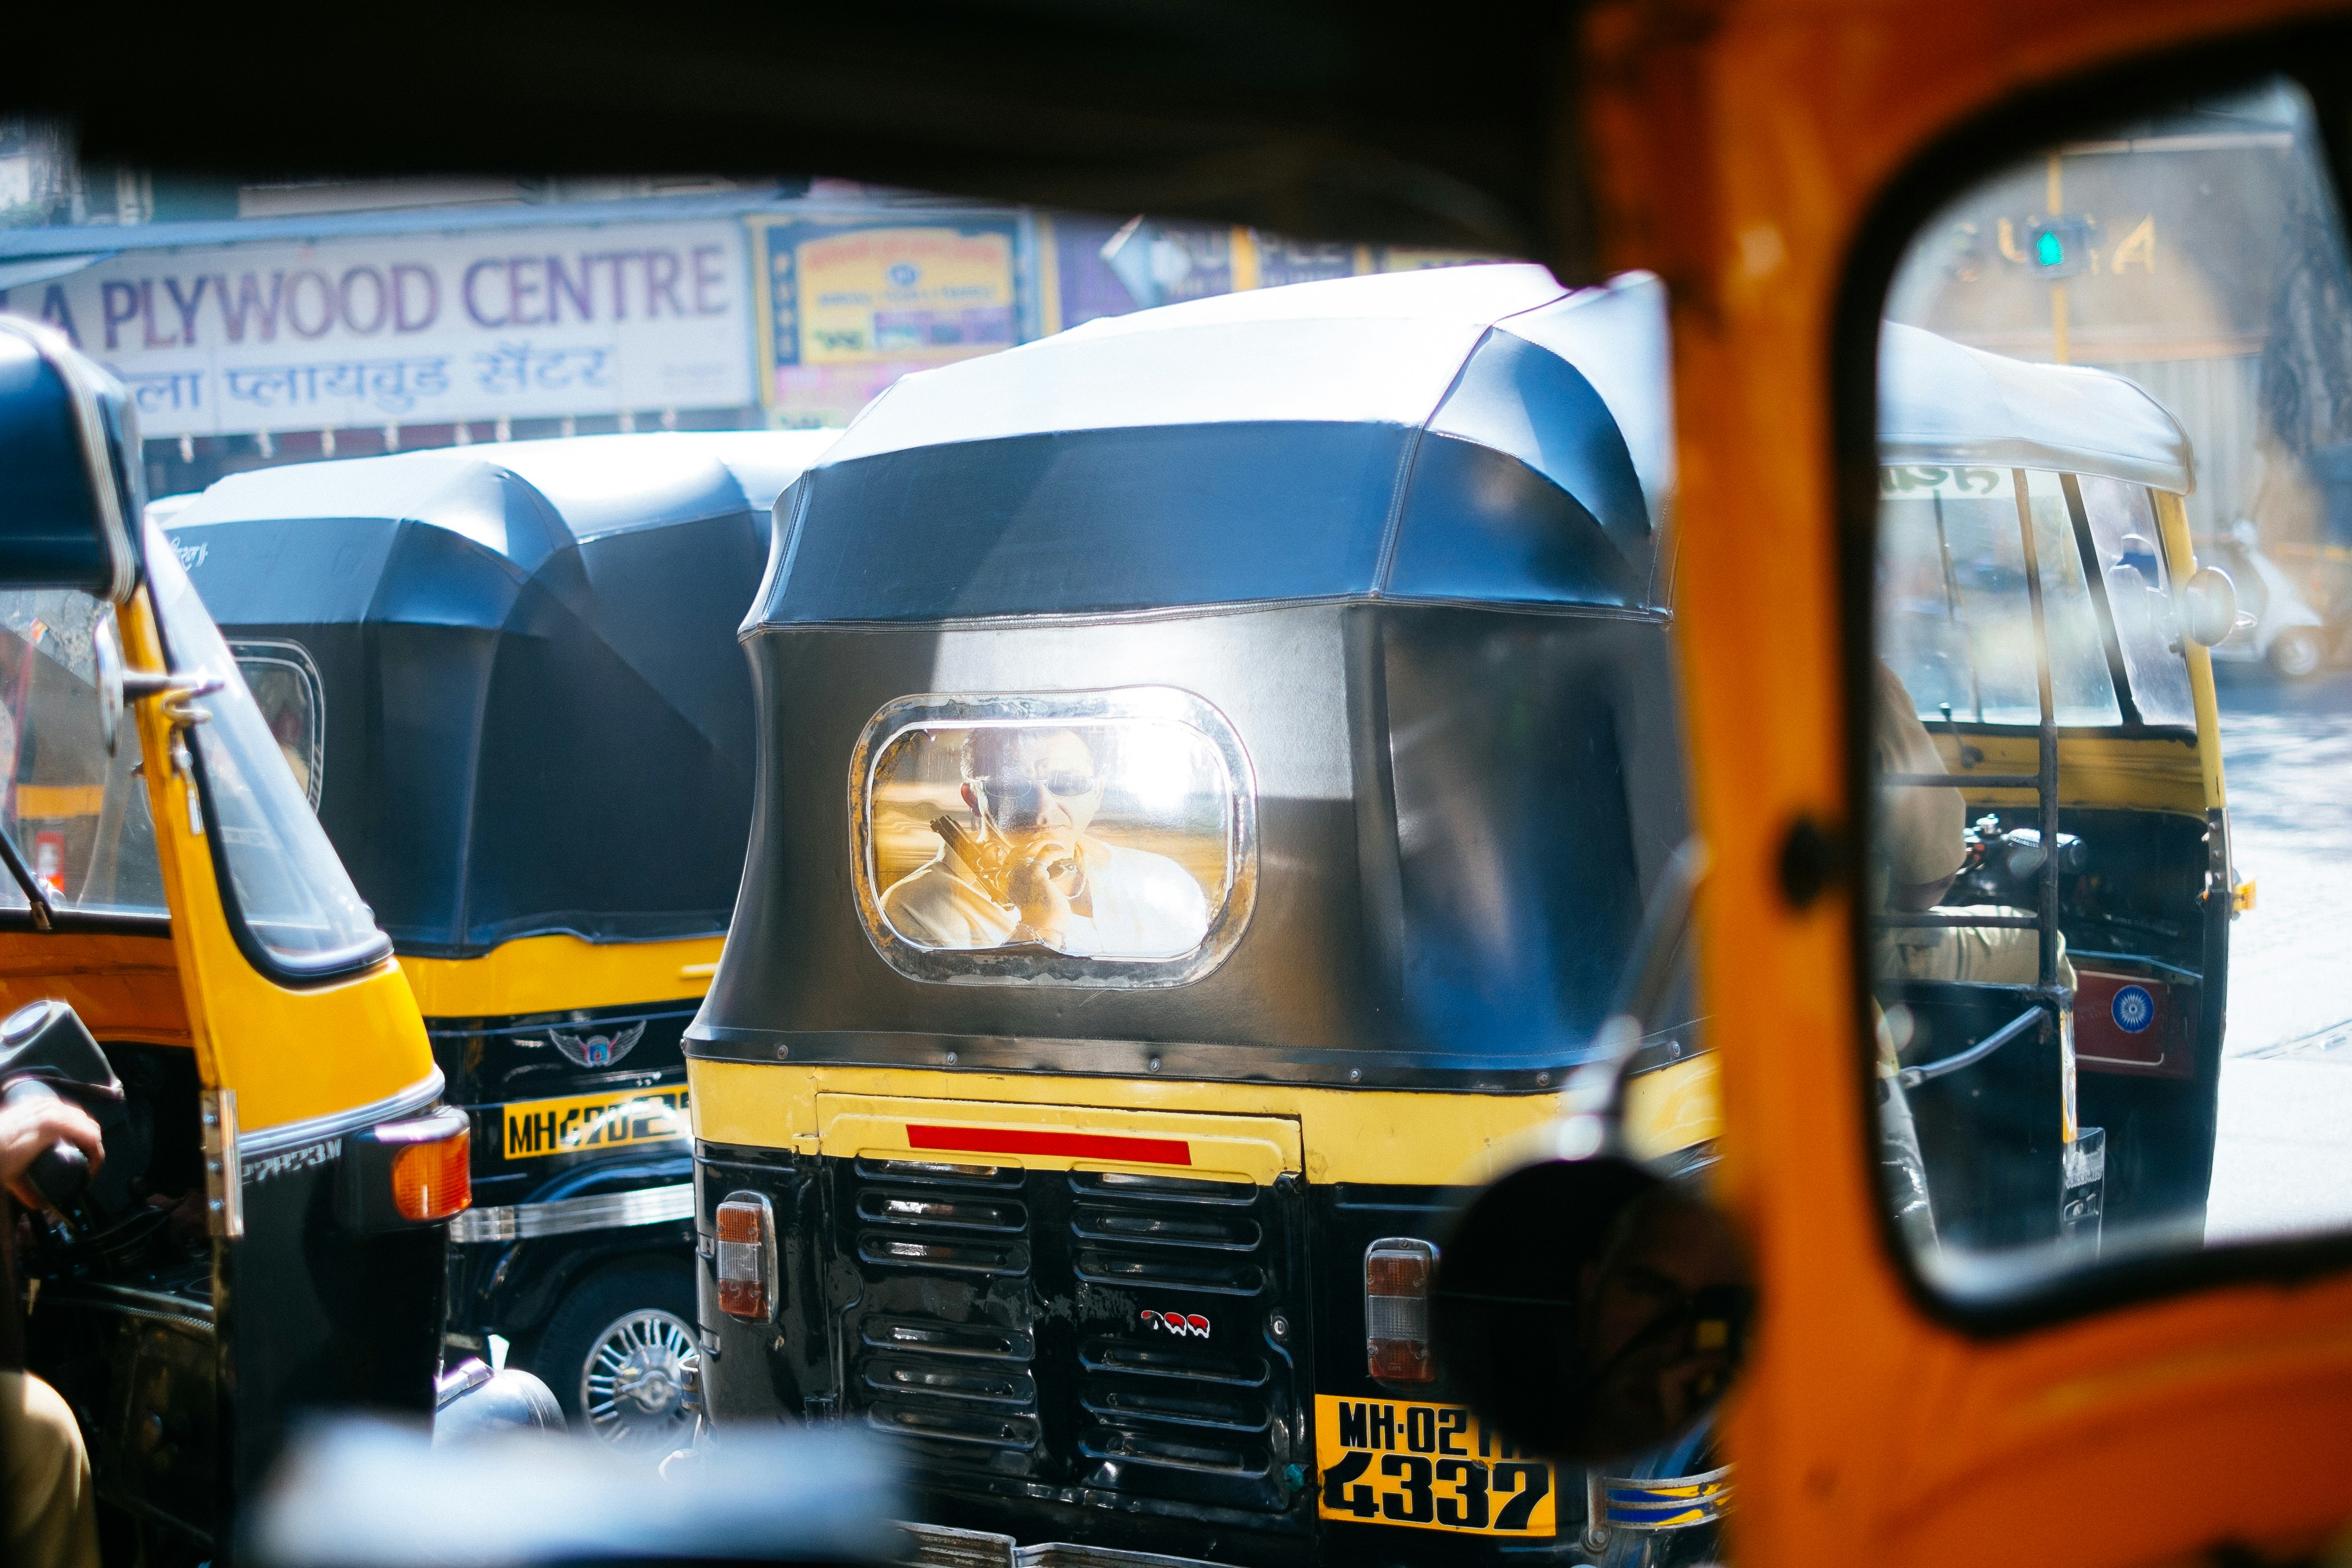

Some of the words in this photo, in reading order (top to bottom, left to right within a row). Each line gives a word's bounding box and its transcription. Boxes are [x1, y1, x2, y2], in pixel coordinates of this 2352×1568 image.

[101, 263, 439, 349] PLYWOOD
[463, 244, 729, 329] CENTRE
[1338, 1400, 1525, 1460] MH-02
[1323, 1450, 1550, 1531] 4337
